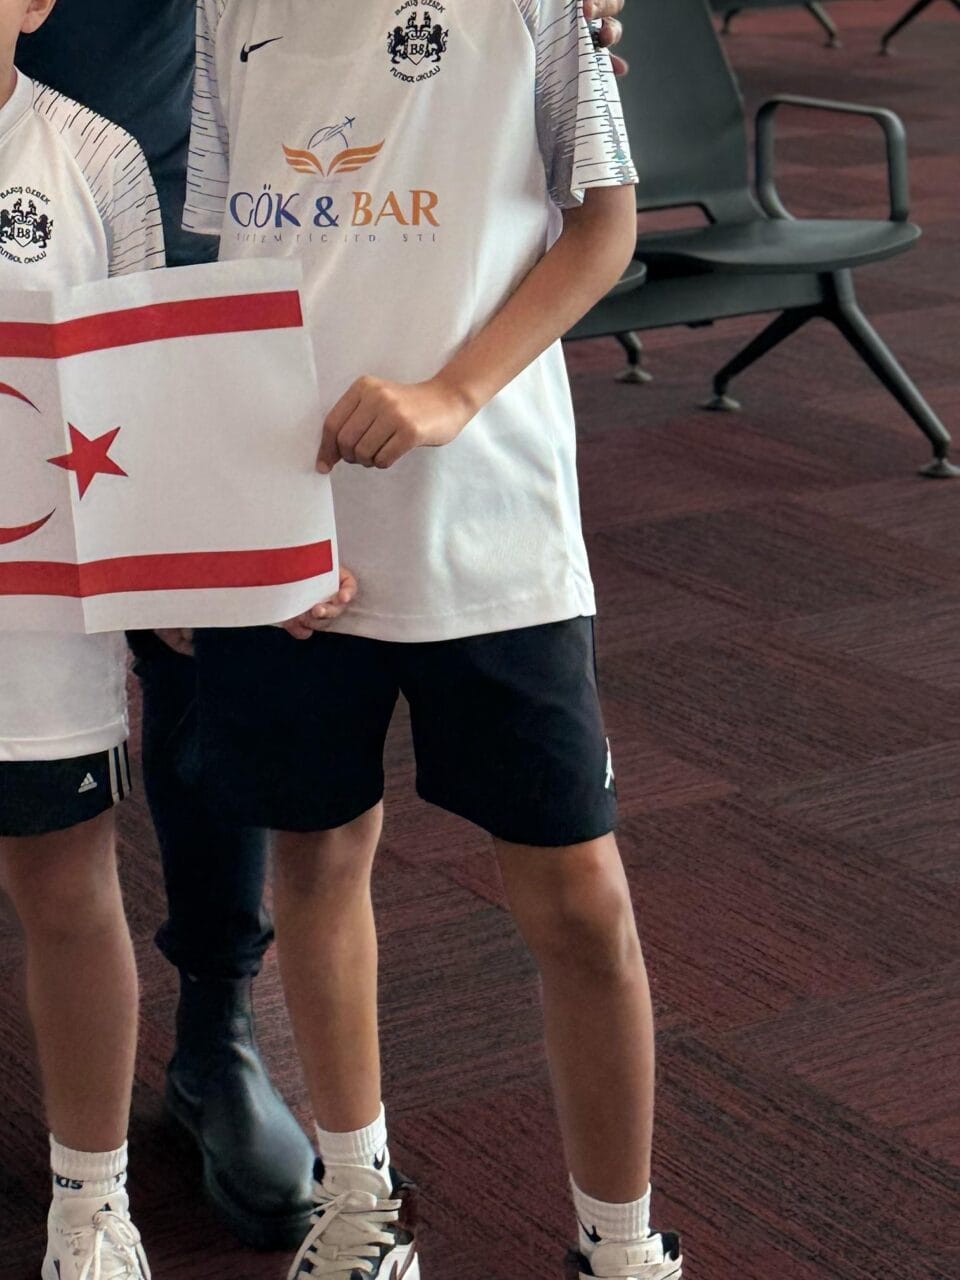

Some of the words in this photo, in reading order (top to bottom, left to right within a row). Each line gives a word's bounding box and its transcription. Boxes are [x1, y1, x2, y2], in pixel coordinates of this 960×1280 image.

[409, 43, 425, 56] B8
[229, 183, 302, 228] GÖK
[312, 195, 340, 228] &
[351, 189, 441, 227] BAR
[16, 227, 31, 239] B8
